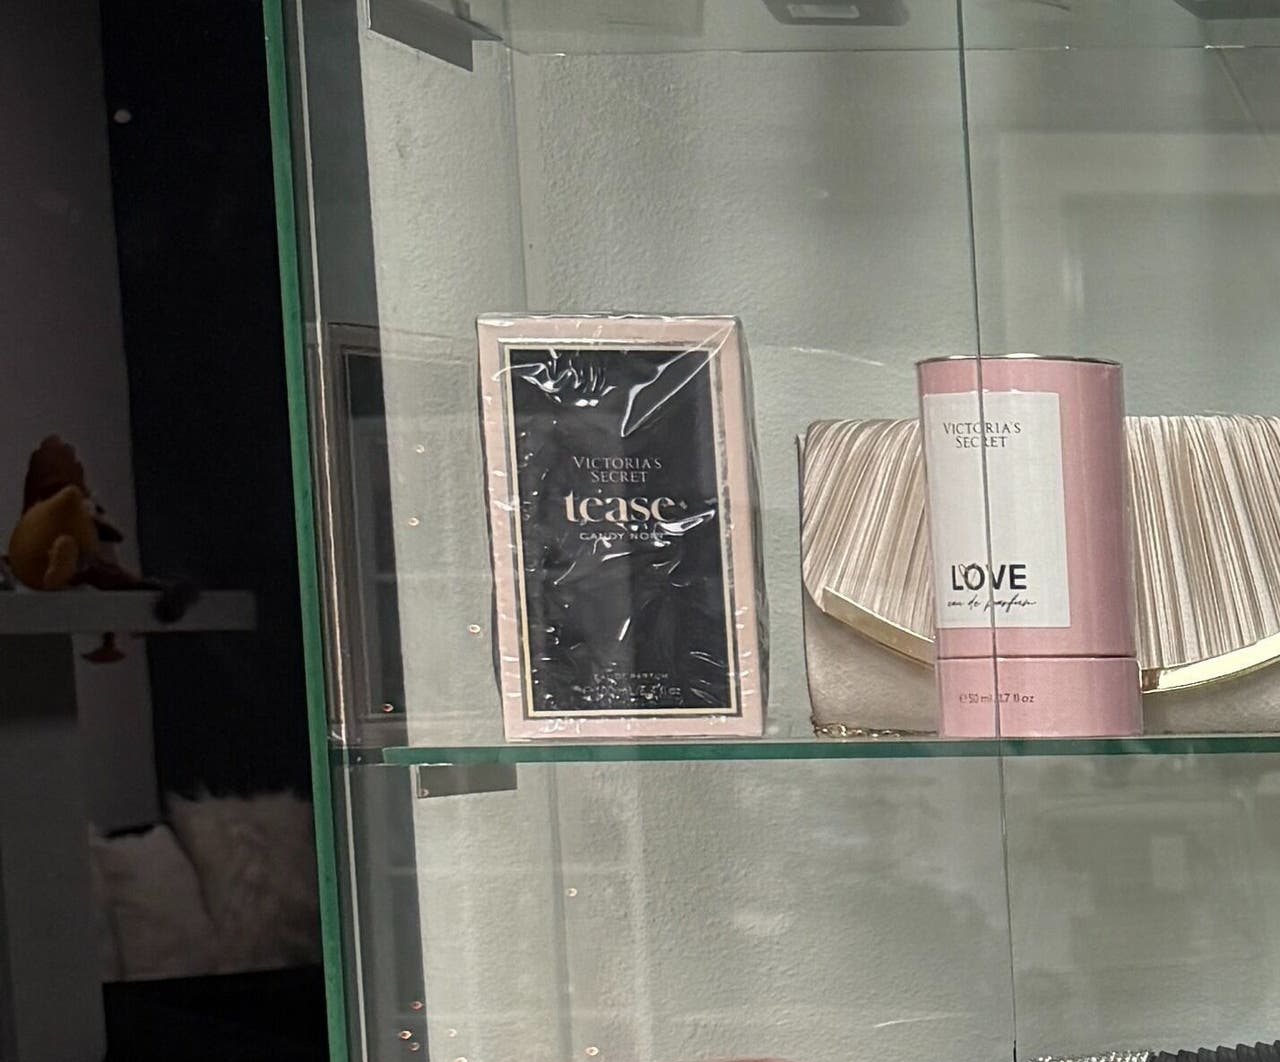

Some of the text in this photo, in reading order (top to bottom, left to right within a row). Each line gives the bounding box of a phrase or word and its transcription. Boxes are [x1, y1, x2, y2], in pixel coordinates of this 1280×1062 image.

[943, 422, 1021, 435] VICTORIA'S
[956, 436, 1008, 448] SECRET
[573, 456, 662, 469] VICTORIA'S
[590, 471, 648, 483] SECRET
[564, 490, 676, 523] tease
[951, 563, 1027, 591] LOVE
[1022, 695, 1034, 703] oz
